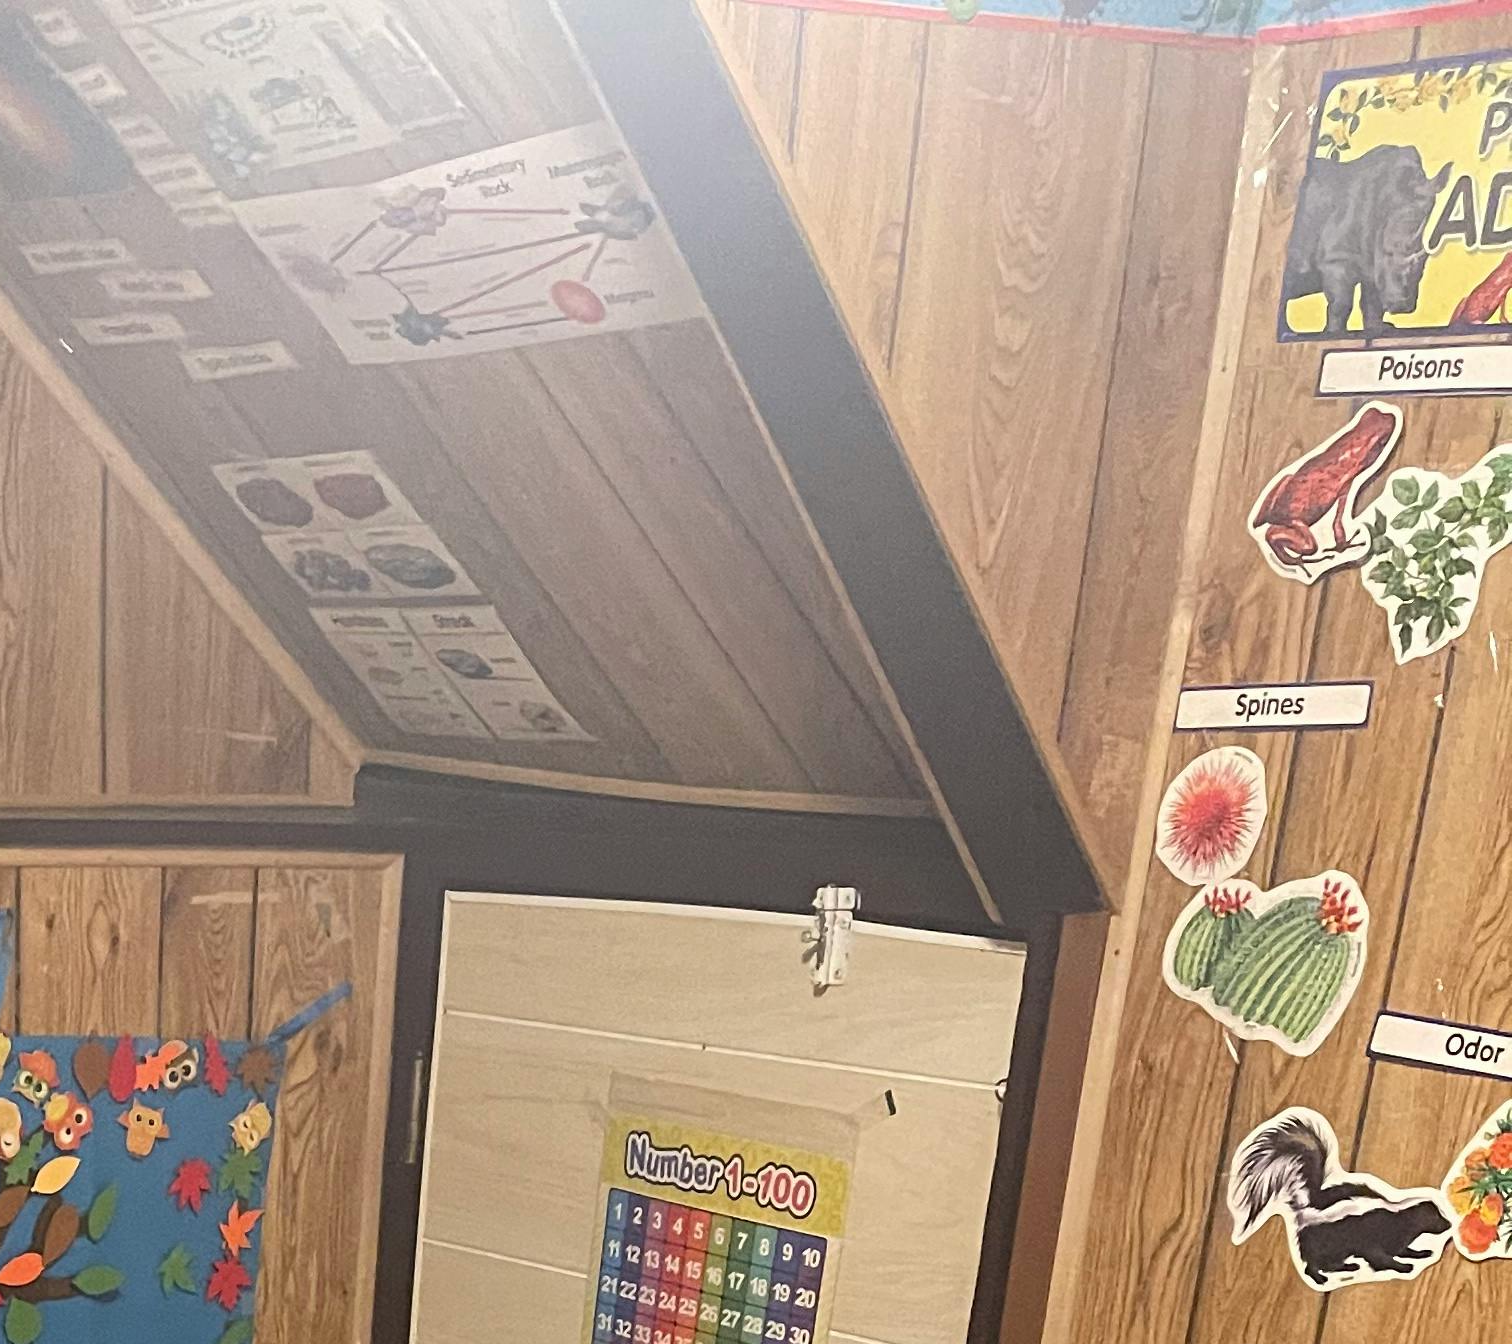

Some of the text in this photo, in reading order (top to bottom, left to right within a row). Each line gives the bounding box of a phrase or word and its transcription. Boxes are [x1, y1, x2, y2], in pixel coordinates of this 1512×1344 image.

[1378, 353, 1465, 381] Poisons
[1234, 691, 1304, 723] Spines
[1444, 1033, 1505, 1064] Odor
[628, 1134, 813, 1213] Number 1-100
[615, 1203, 821, 1268] 1 2 3 4 5 6 7 8 9 10
[626, 1244, 641, 1264] 12
[644, 1250, 660, 1269] 13
[664, 1254, 680, 1274] 14
[685, 1260, 702, 1280] 15
[728, 1271, 745, 1290] 17
[772, 1283, 791, 1302] 19
[794, 1287, 816, 1308] 20
[597, 1313, 612, 1332] 31
[615, 1319, 632, 1338] 32
[601, 1275, 618, 1294] 21
[619, 1280, 637, 1300] 22
[638, 1285, 656, 1306] 23
[658, 1291, 676, 1312] 24
[679, 1297, 697, 1317] 25
[721, 1309, 741, 1328] 27
[765, 1320, 786, 1341] 29
